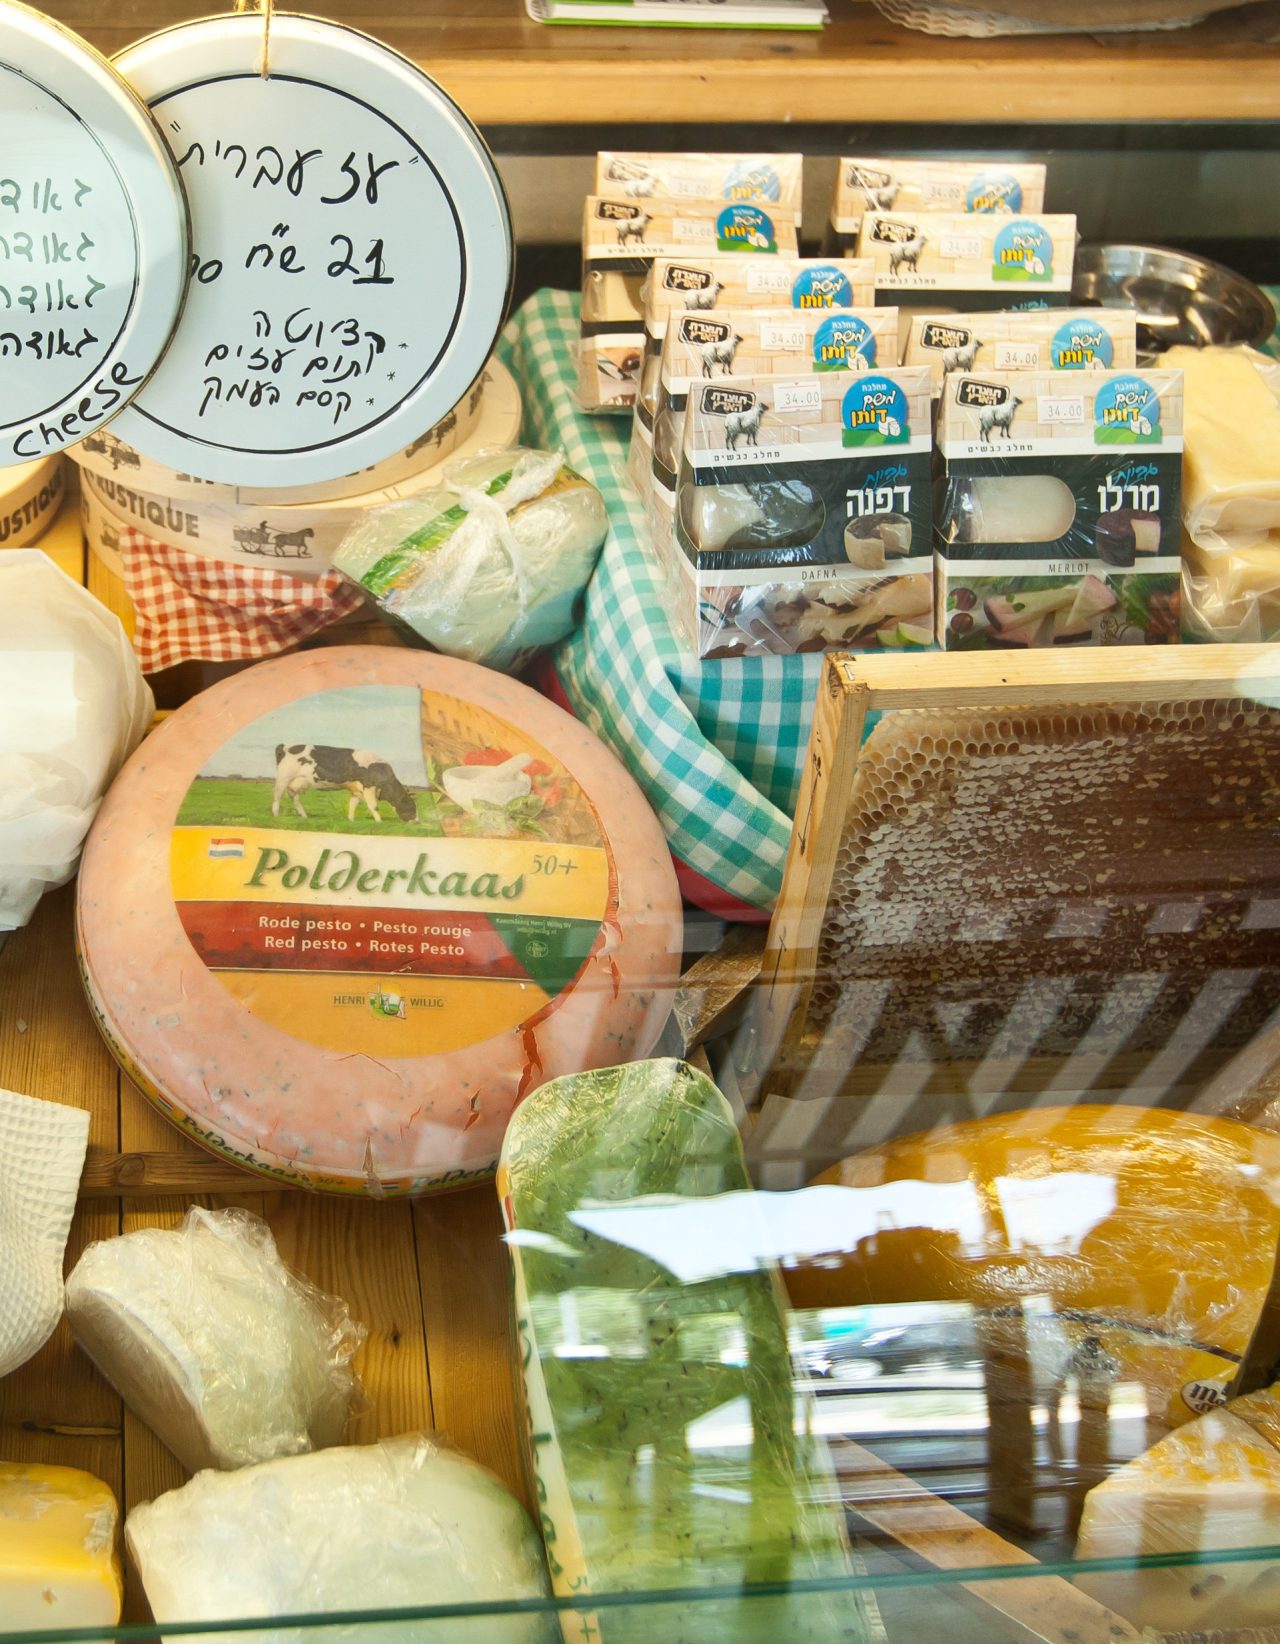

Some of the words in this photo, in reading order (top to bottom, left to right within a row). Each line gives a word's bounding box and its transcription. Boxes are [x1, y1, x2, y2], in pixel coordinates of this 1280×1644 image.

[681, 225, 713, 237] 34.00
[724, 225, 757, 238] דותן
[326, 233, 395, 285] 21
[1000, 247, 1034, 265] דותן
[757, 276, 789, 288] 34.00
[799, 293, 834, 309] דותן
[0, 329, 100, 360] גאודה
[770, 332, 805, 345] 34.00
[821, 342, 858, 363] דותן
[1004, 351, 1037, 365] 34.00
[1058, 347, 1094, 366] דותן
[861, 383, 887, 392] מחלבת
[785, 392, 820, 405] 34.00
[862, 391, 896, 411] משק
[1115, 391, 1149, 408] משק
[851, 404, 889, 428] דותן
[1047, 405, 1082, 418] 34.00
[1102, 406, 1140, 425] דותן
[752, 450, 781, 460] מחלב
[967, 445, 1002, 453] כבשים
[1006, 444, 1034, 452] מחלב
[713, 453, 749, 462] כבשים
[846, 485, 912, 518] דפנה
[1097, 474, 1160, 514] מרלו
[801, 569, 837, 581] DAFNA
[1048, 563, 1090, 573] MERLOT
[243, 846, 526, 900] Polderkaas
[529, 854, 579, 877] 50+
[258, 915, 300, 930] Rode
[305, 919, 352, 934] pesto
[373, 921, 418, 935] Pesto
[423, 925, 472, 938] rouge
[265, 936, 295, 949] Red
[301, 938, 348, 953] pesto
[369, 939, 415, 954] Rotes
[420, 942, 465, 956] Pesto
[333, 995, 366, 1006] HENRI
[410, 997, 445, 1008] WILLIG
